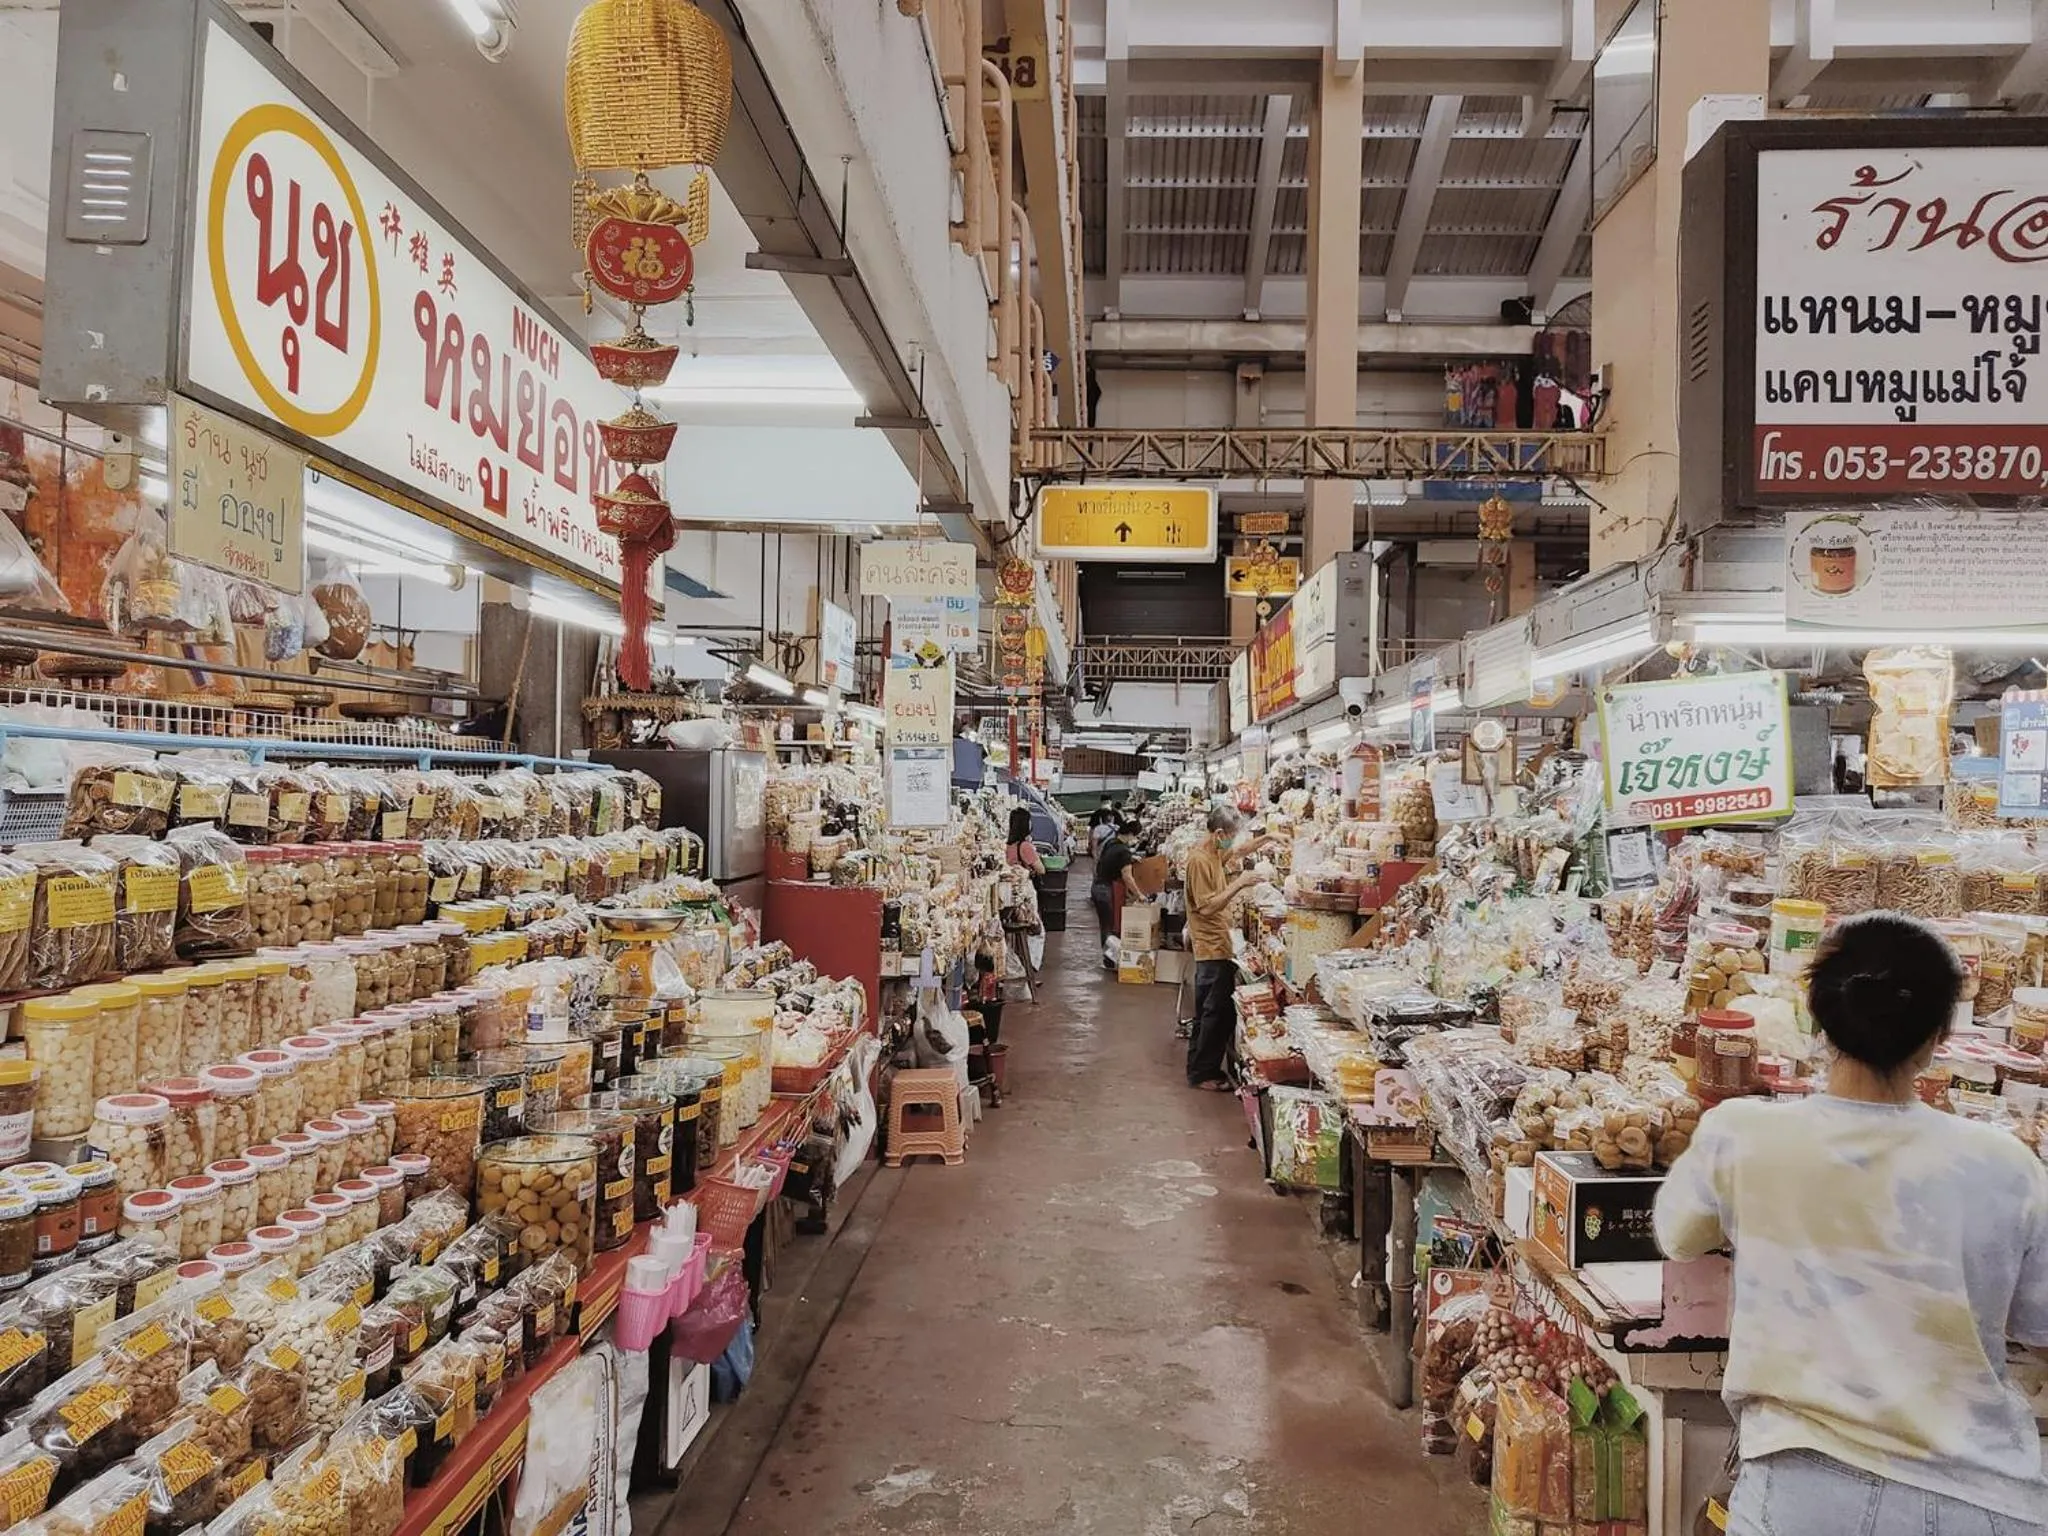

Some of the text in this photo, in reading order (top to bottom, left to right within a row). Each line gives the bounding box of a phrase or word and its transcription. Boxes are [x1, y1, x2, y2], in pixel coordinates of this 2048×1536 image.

[247, 153, 354, 395] นุช
[620, 236, 665, 280] 福
[512, 305, 560, 380] NUCH
[1764, 295, 2048, 354] แหนม-หมู
[1765, 350, 2027, 423] แคบหมูแม่โจ้
[184, 411, 270, 488] ร้าน นุช
[407, 433, 474, 497] ไม่มีสาขา
[183, 464, 199, 510] มี
[1627, 695, 1762, 733] น้ำพริกหนุ่ม
[1618, 724, 1778, 796] เจ๊หงษ์
[1651, 791, 1769, 820] 081-9982541
